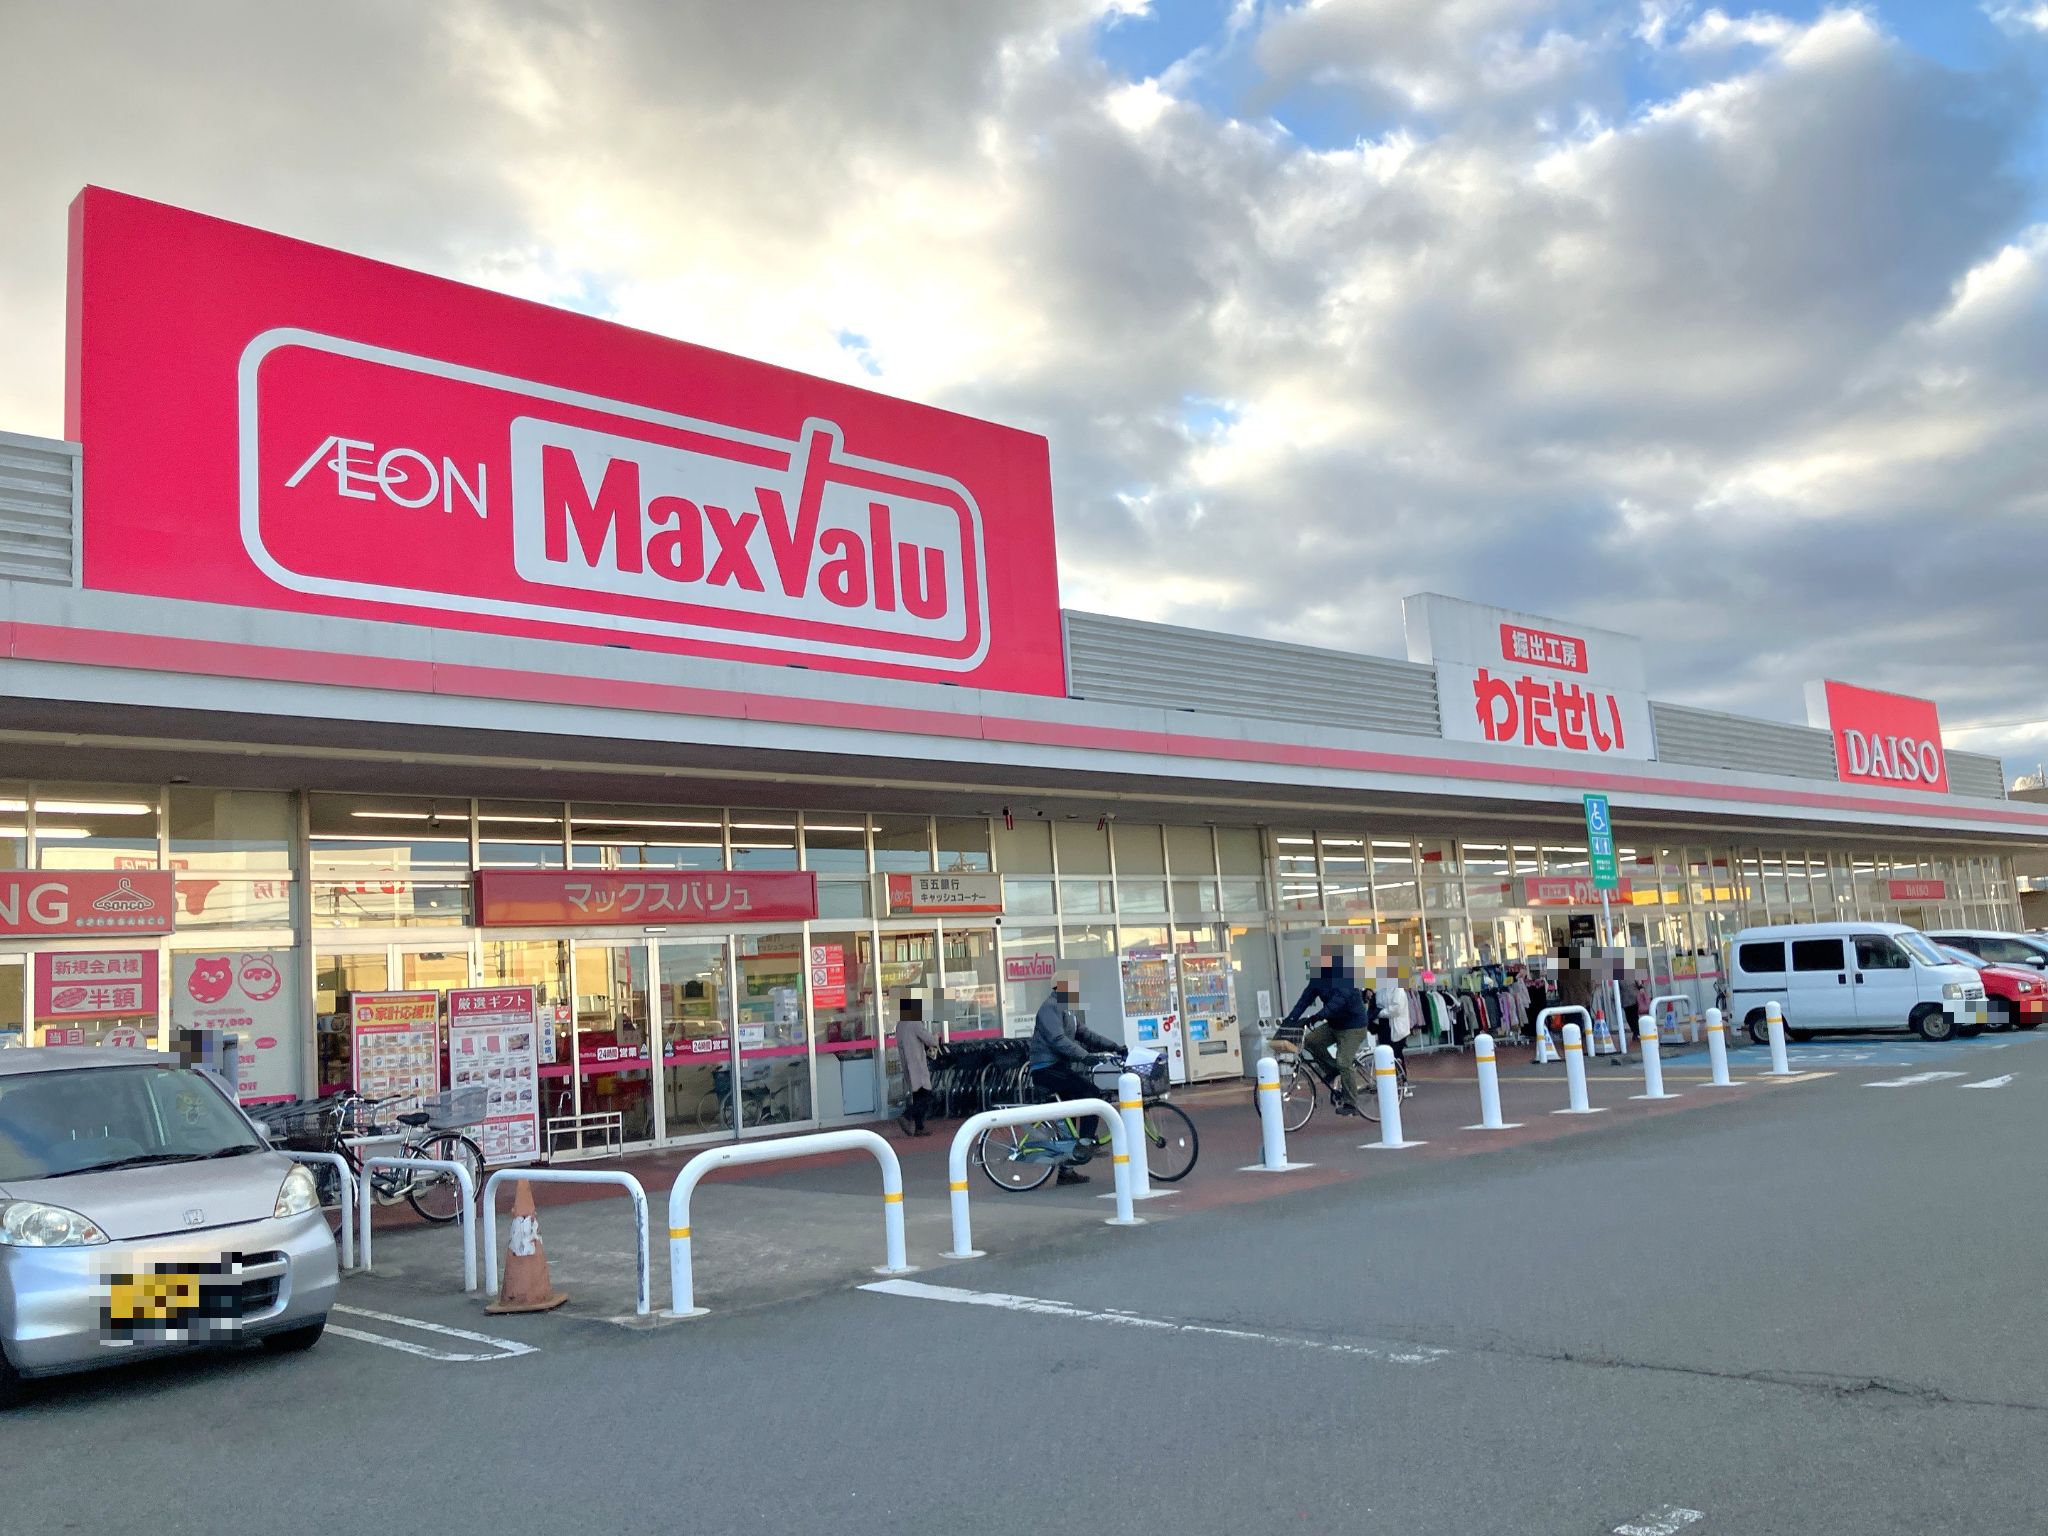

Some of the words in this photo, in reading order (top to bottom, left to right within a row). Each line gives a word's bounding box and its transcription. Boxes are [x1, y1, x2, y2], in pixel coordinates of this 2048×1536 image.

[541, 427, 947, 620] MaxValu
[1512, 630, 1577, 667] 掘出工房
[1473, 667, 1624, 752] わたせい
[1843, 729, 1939, 783] DAISO
[564, 881, 752, 913] マックスバリュ
[920, 879, 960, 890] 百五銀行
[920, 893, 986, 903] キャッシュコーナー
[1009, 953, 1052, 976] MaxValu
[88, 987, 136, 1009] 半額
